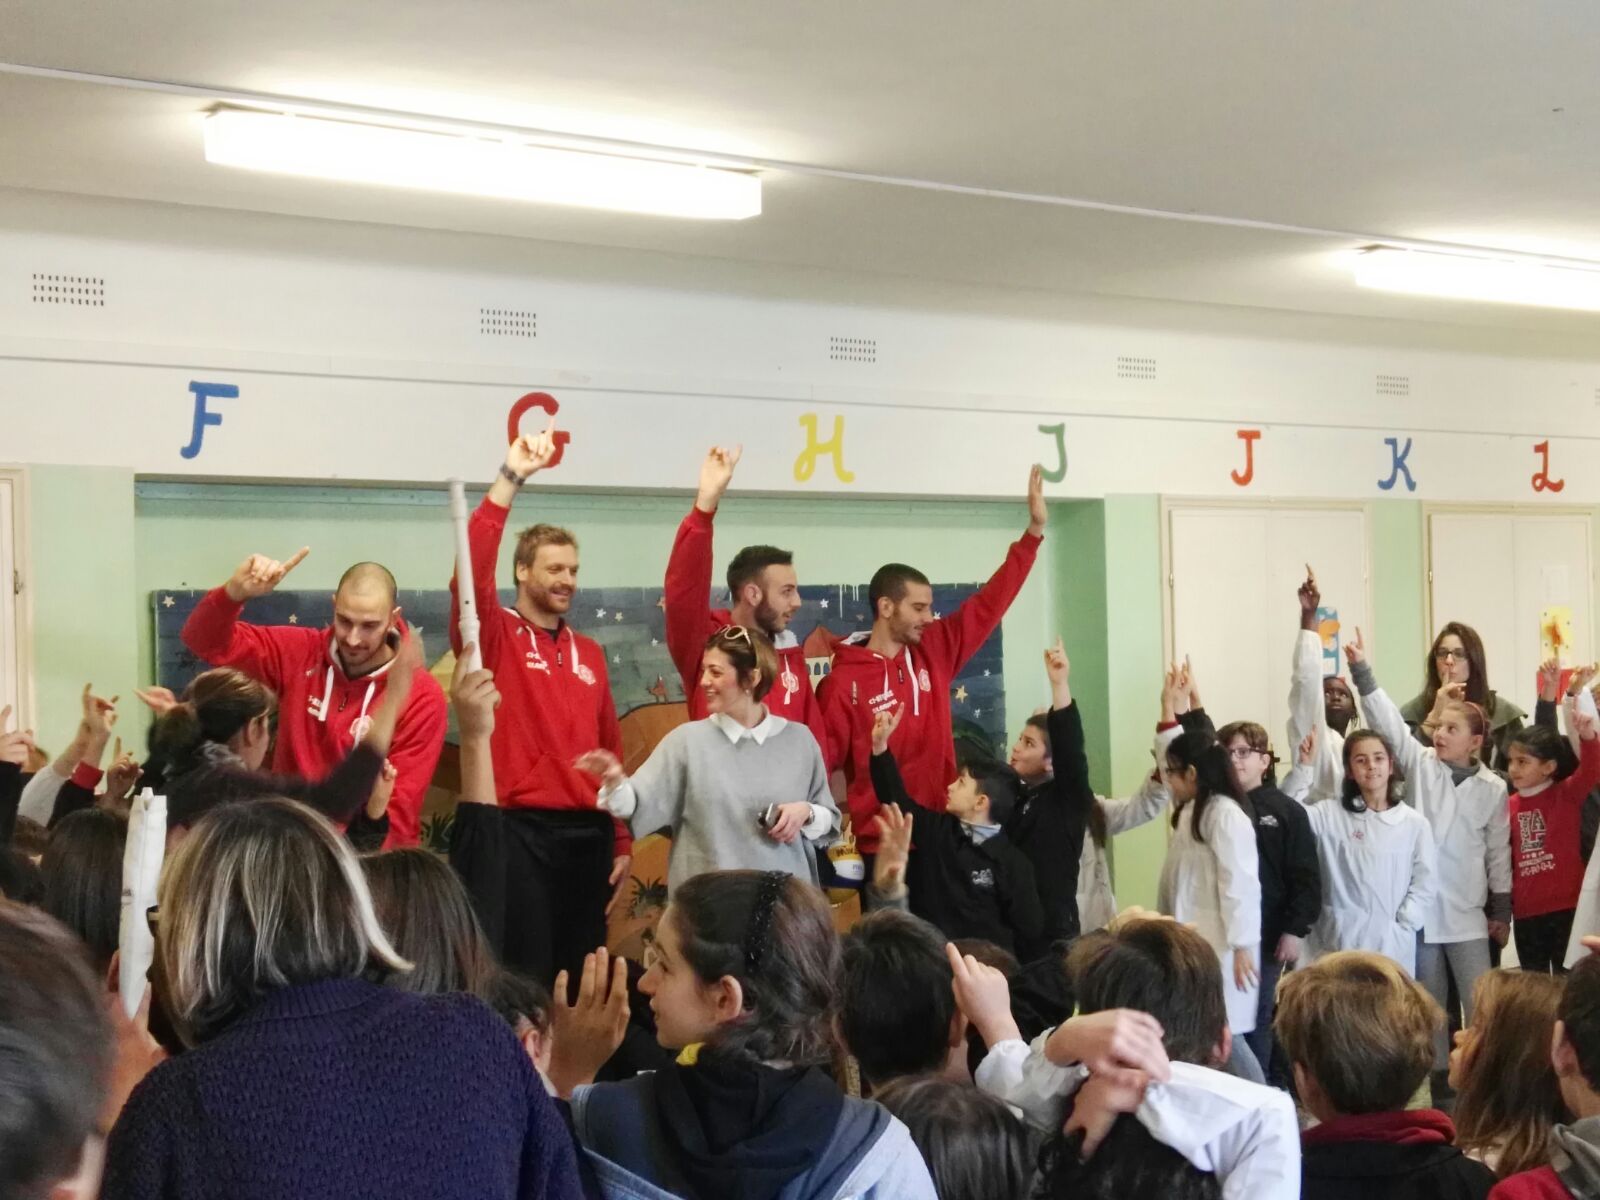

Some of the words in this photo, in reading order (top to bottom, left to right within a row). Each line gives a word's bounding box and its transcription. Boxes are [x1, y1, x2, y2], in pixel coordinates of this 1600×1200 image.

[181, 381, 238, 458] F
[507, 391, 571, 469] G
[793, 414, 854, 484] H
[1231, 429, 1262, 487] J
[1377, 437, 1417, 491] K
[1531, 439, 1565, 493] L
